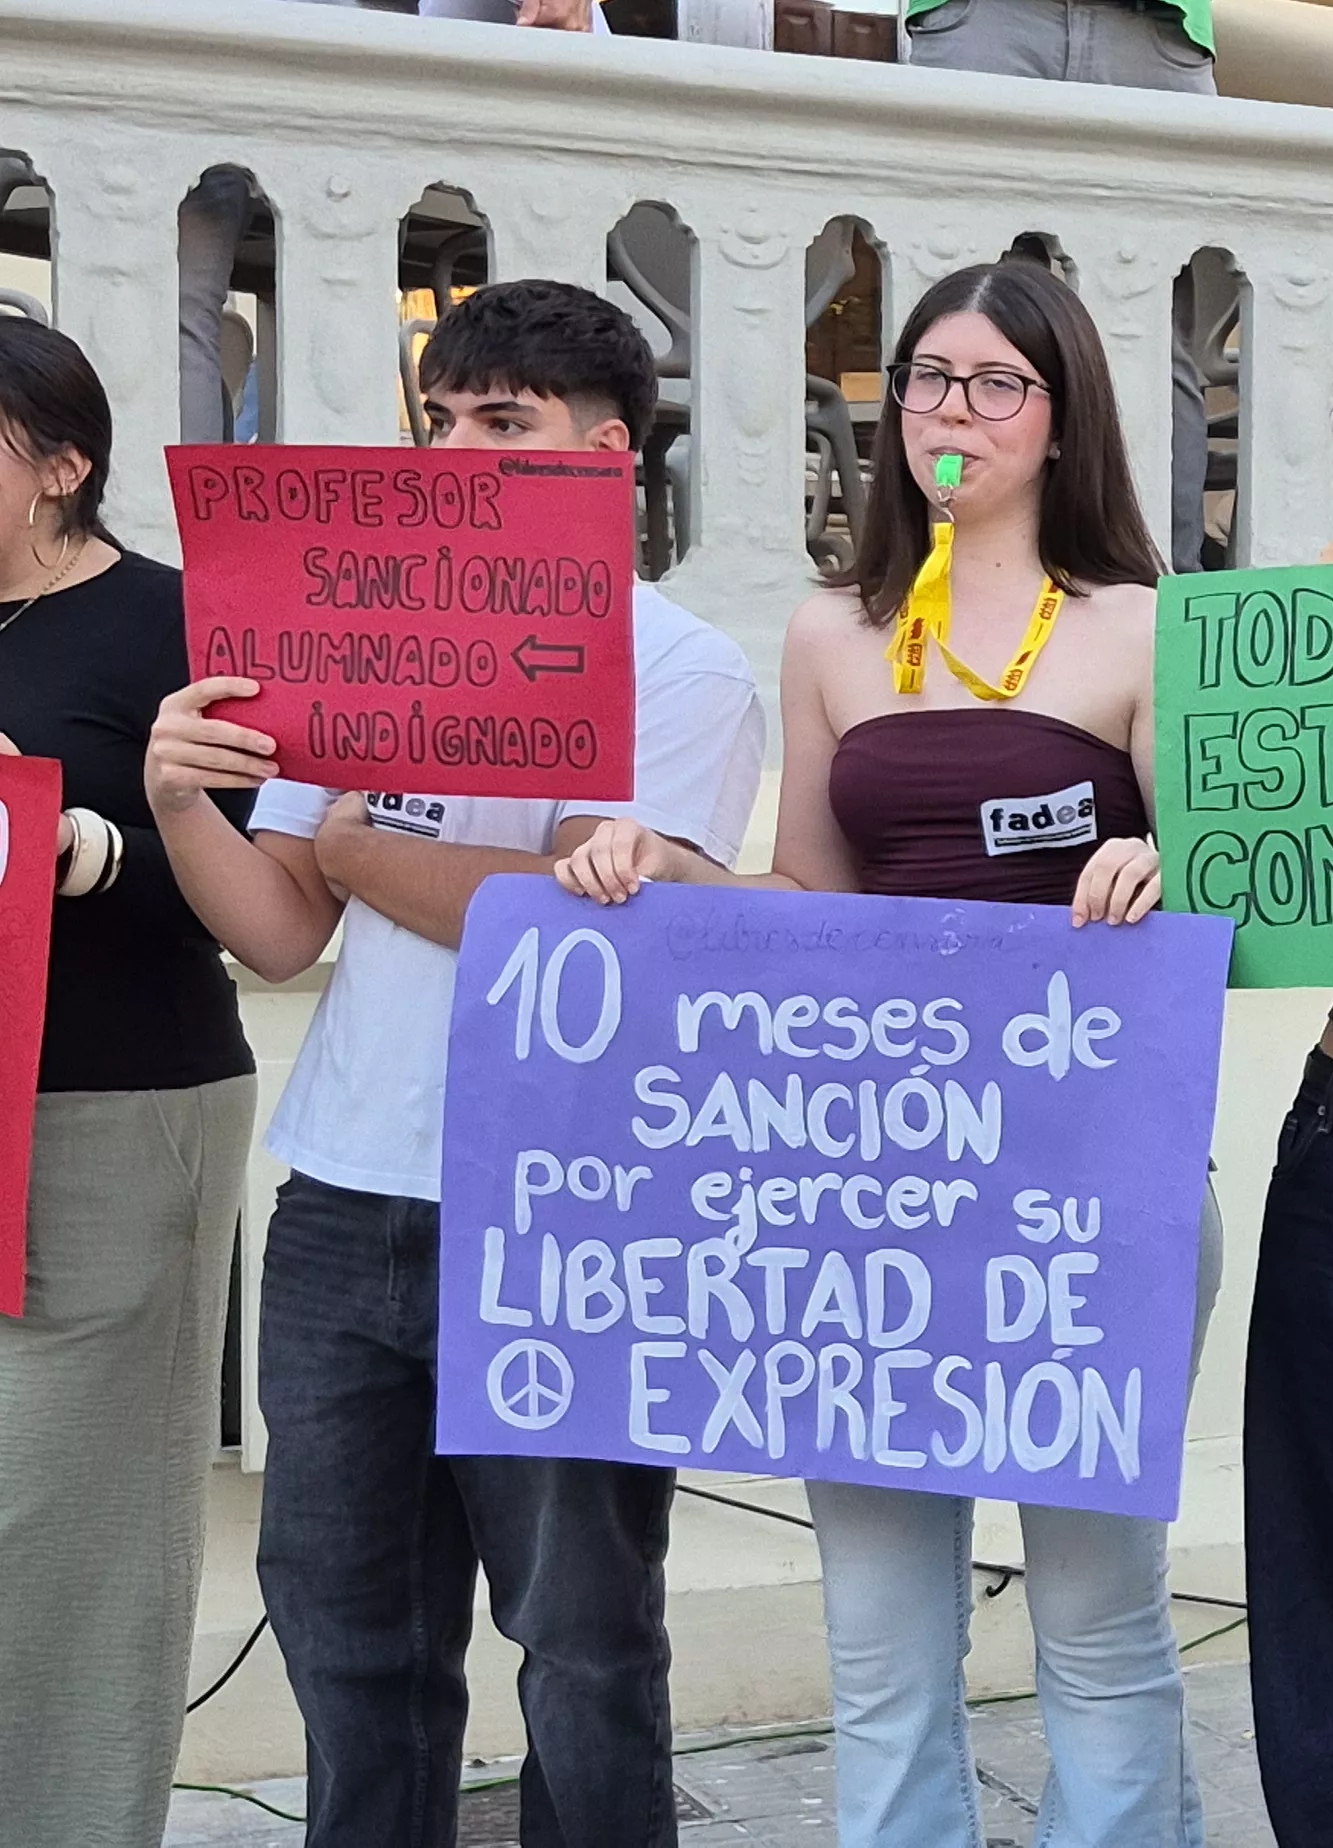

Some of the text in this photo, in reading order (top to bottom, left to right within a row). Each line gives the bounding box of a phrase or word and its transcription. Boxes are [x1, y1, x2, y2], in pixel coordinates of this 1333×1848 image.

[187, 465, 503, 530] PROFESOR
[205, 627, 499, 687] ALUMNADO
[990, 798, 1093, 833] fadea
[486, 927, 1122, 1081] 10 meses de
[630, 1064, 1002, 1165] SANCIÓN
[514, 1150, 1101, 1260] por ejercer su
[479, 1226, 1104, 1349] LIBERTAD DE
[628, 1339, 1141, 1484] EXPRESIÓN
